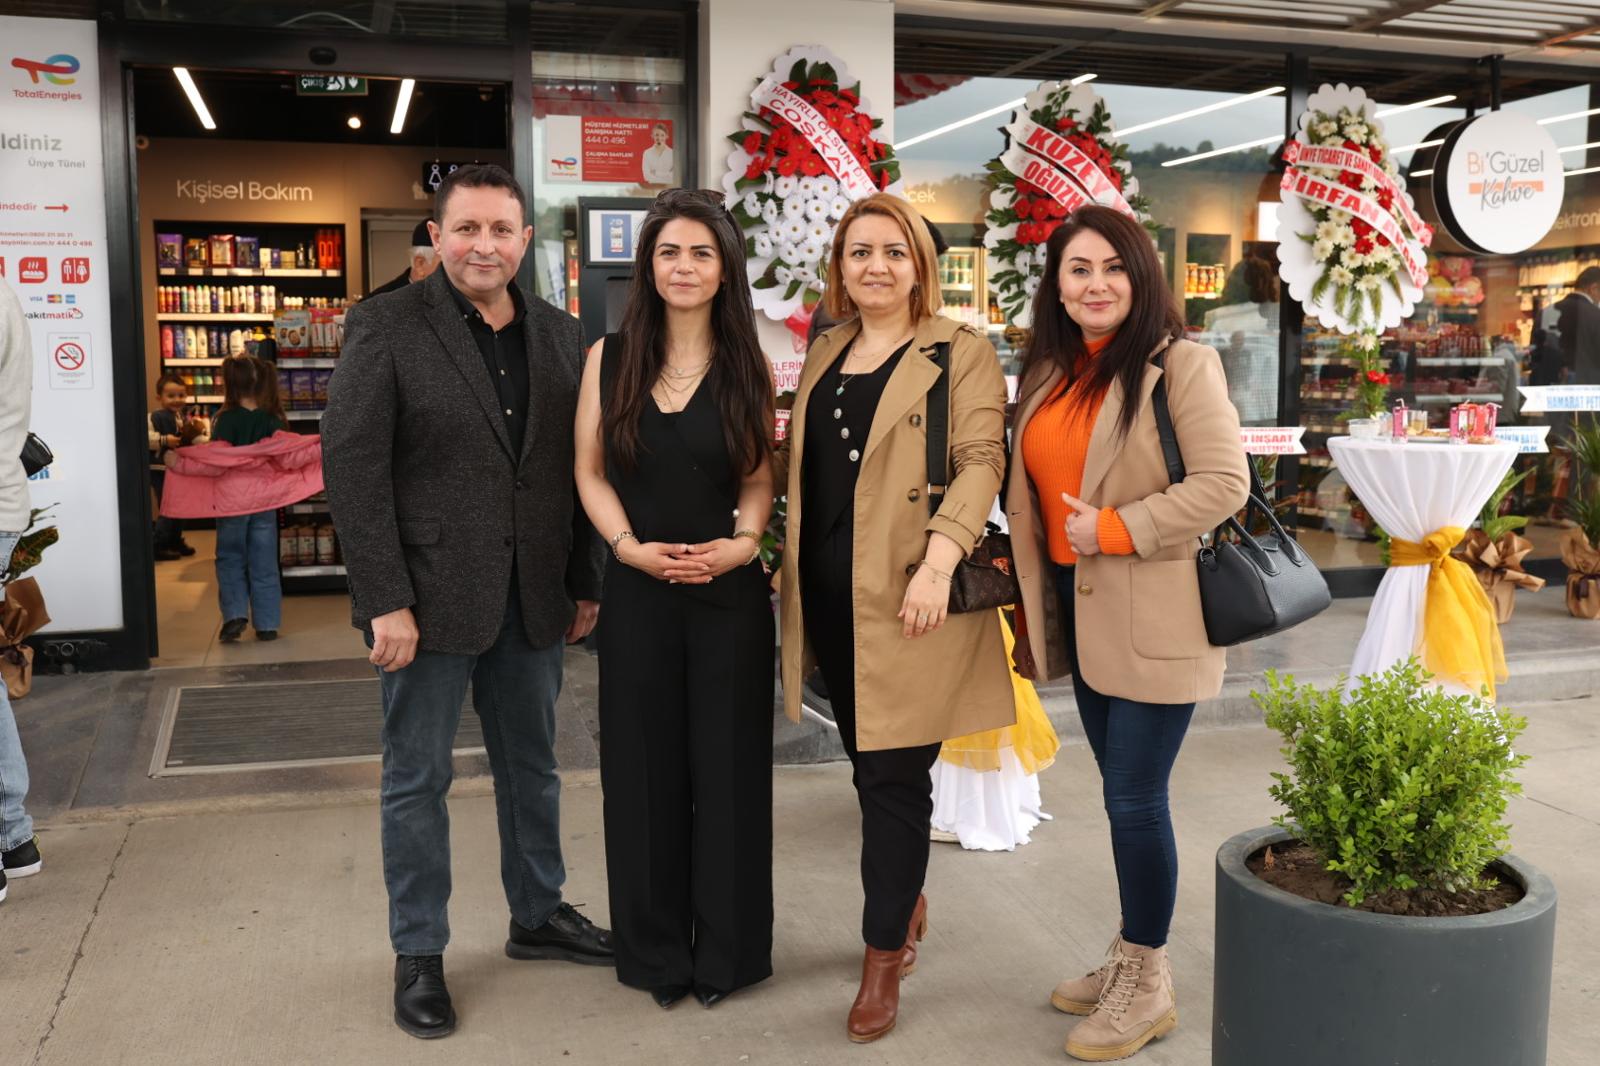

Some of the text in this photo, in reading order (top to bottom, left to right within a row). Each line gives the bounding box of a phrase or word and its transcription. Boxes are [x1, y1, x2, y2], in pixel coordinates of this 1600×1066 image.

[13, 89, 82, 101] TotalEnergies
[585, 136, 626, 145] 444 0 496
[772, 86, 819, 120] HAYIRLI
[818, 120, 854, 165] OLSUN
[28, 156, 86, 169] Ünye Tünel
[1025, 127, 1112, 198] KUZEY
[176, 180, 313, 204] Kişisel Bakım
[1295, 174, 1380, 222] İRFAN
[1481, 176, 1535, 212] Kahve
